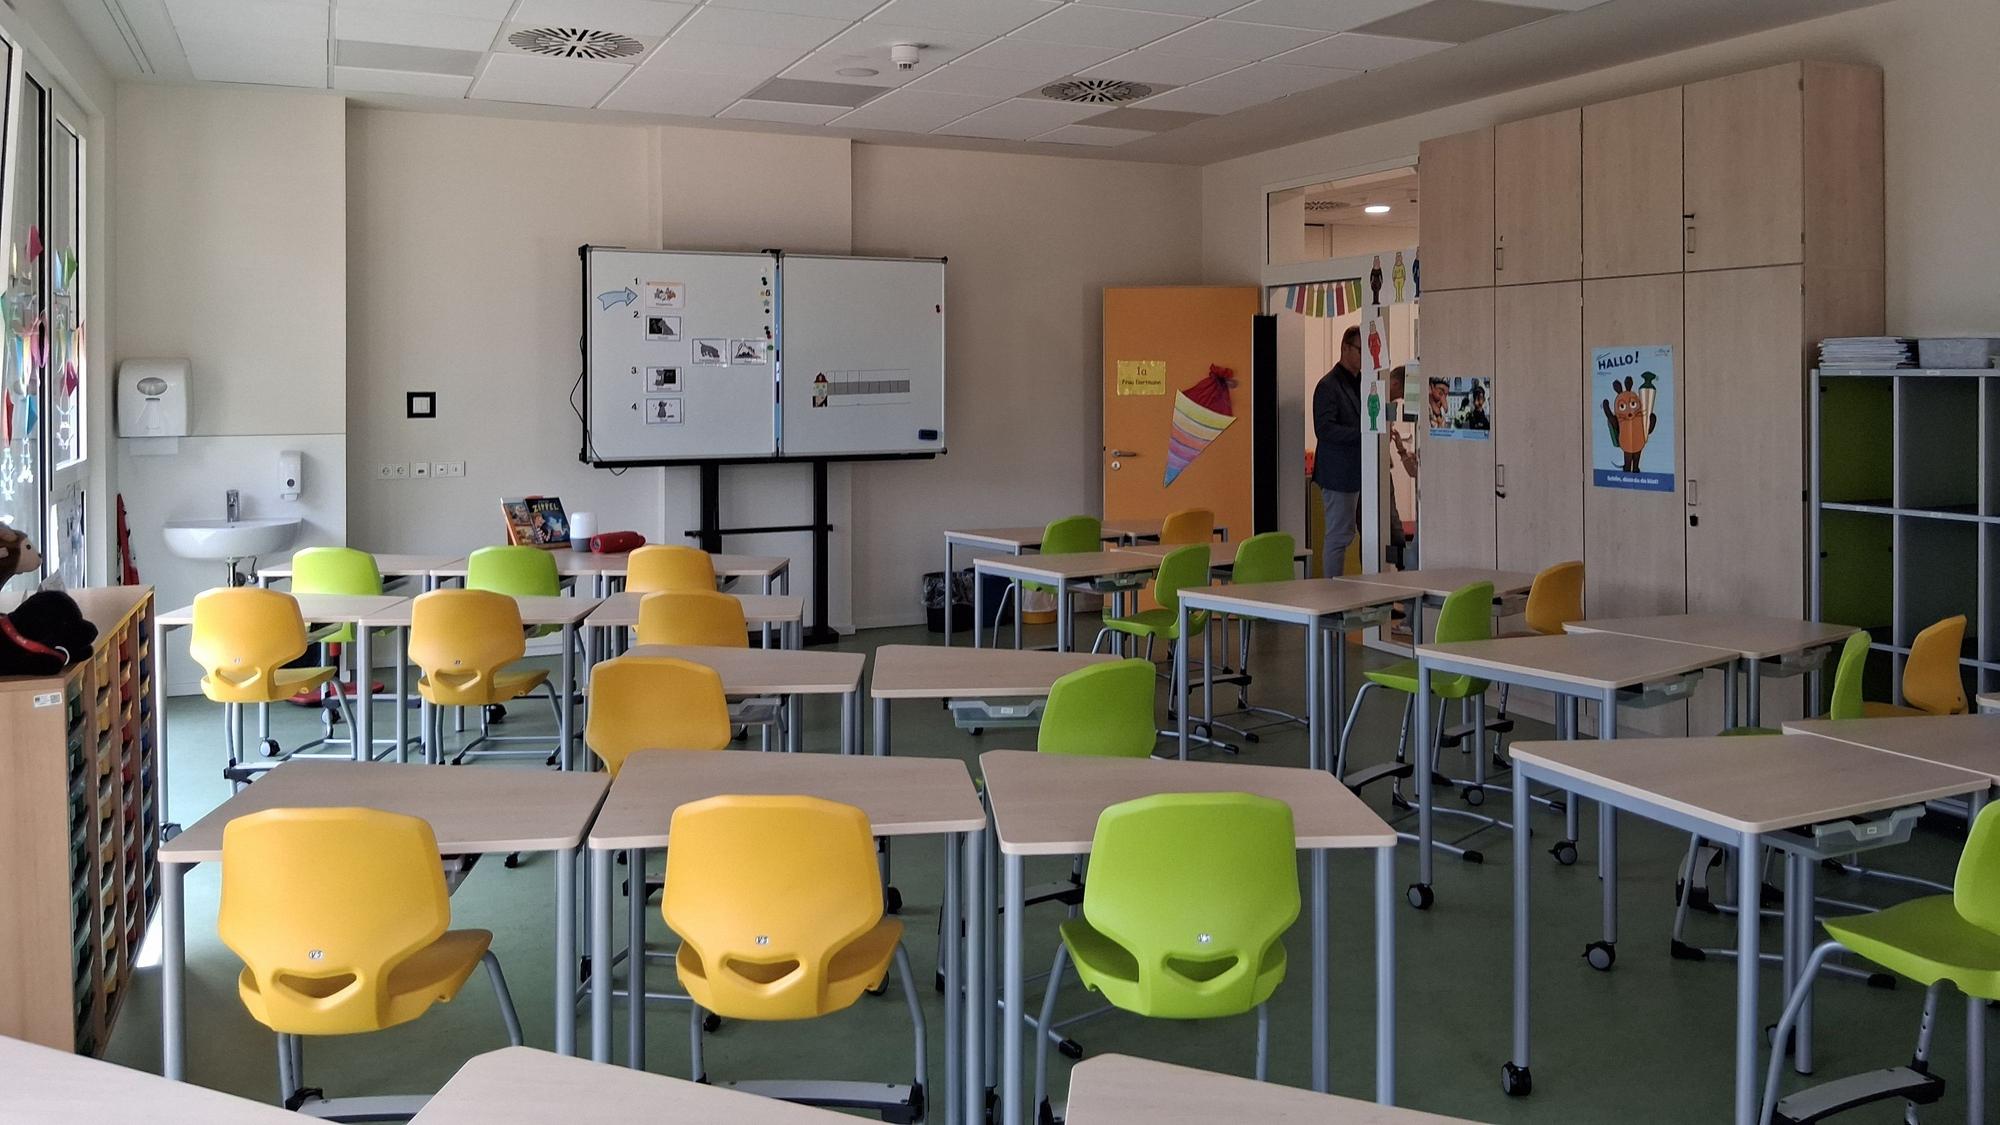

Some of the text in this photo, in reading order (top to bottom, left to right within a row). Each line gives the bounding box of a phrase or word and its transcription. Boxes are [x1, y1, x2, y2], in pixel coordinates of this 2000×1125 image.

[633, 277, 638, 285] 1
[633, 310, 639, 319] 2
[1598, 351, 1639, 370] HALLO!
[631, 366, 637, 375] 3
[1136, 366, 1147, 376] 1a
[631, 402, 637, 411] 4
